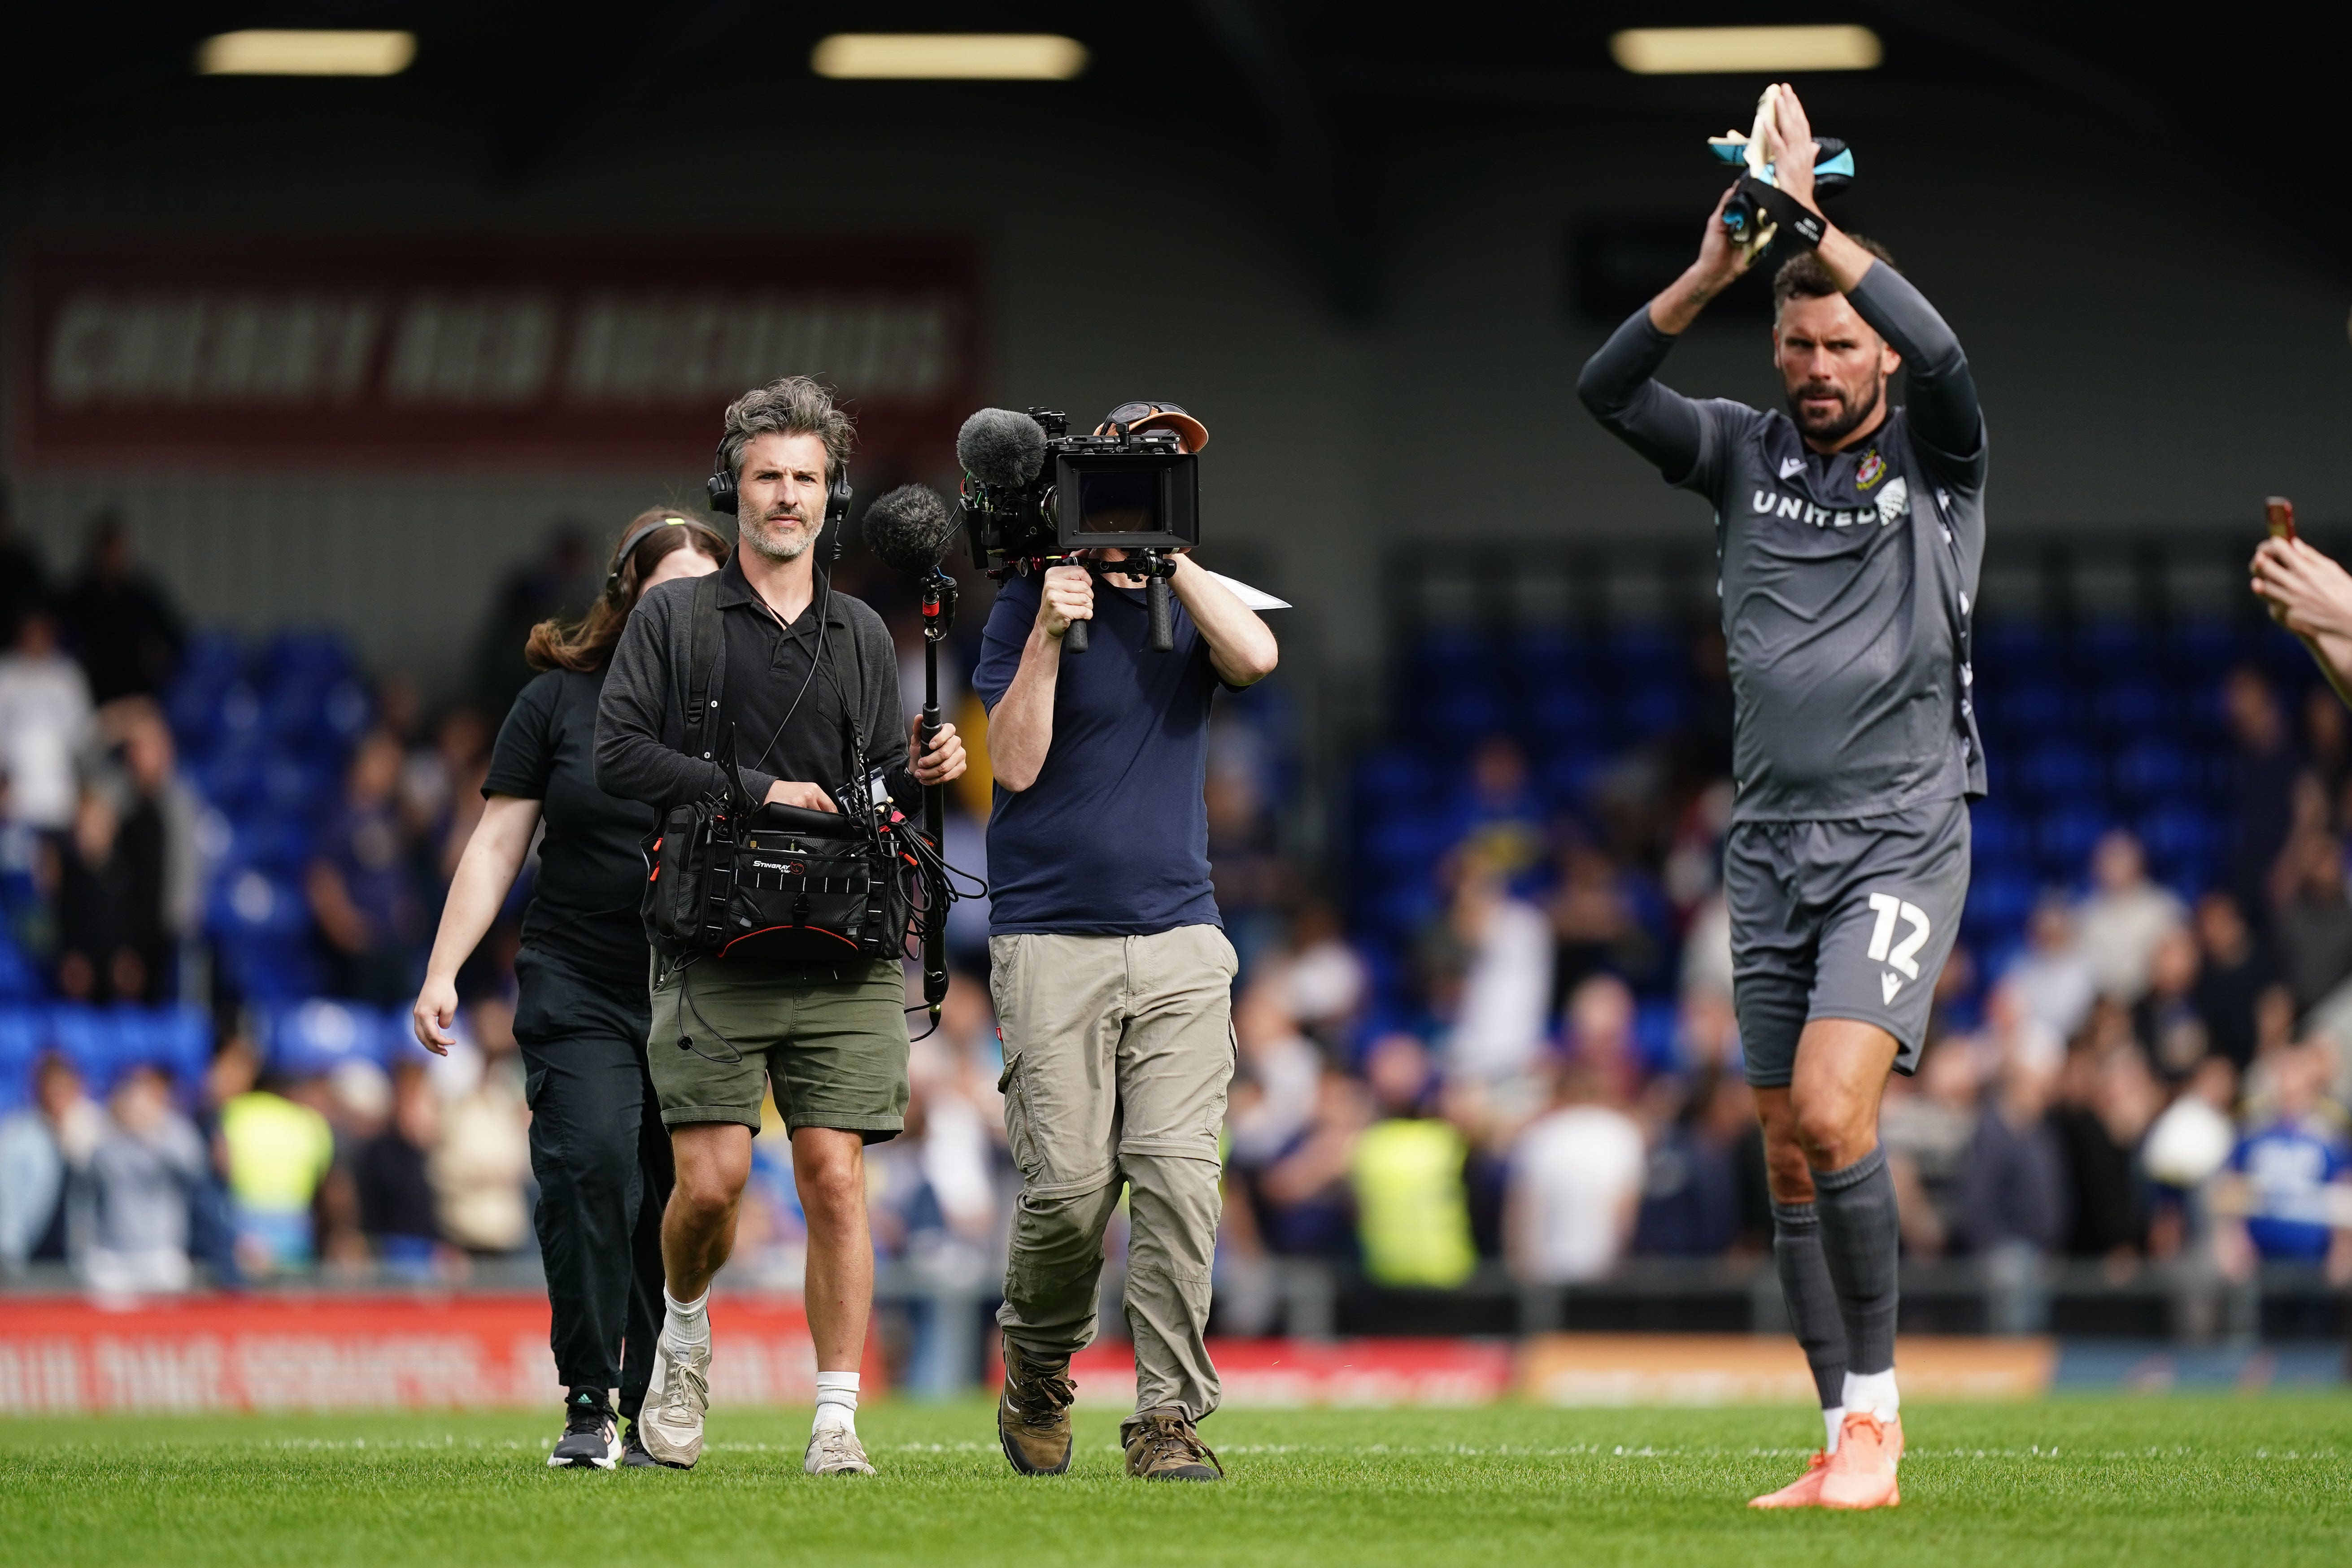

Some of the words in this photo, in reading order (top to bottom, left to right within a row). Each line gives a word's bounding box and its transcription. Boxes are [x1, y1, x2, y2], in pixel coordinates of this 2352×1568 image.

[1752, 490, 1877, 527] UNITED
[753, 860, 791, 870] STINGRAY
[1867, 893, 1930, 980] 12
